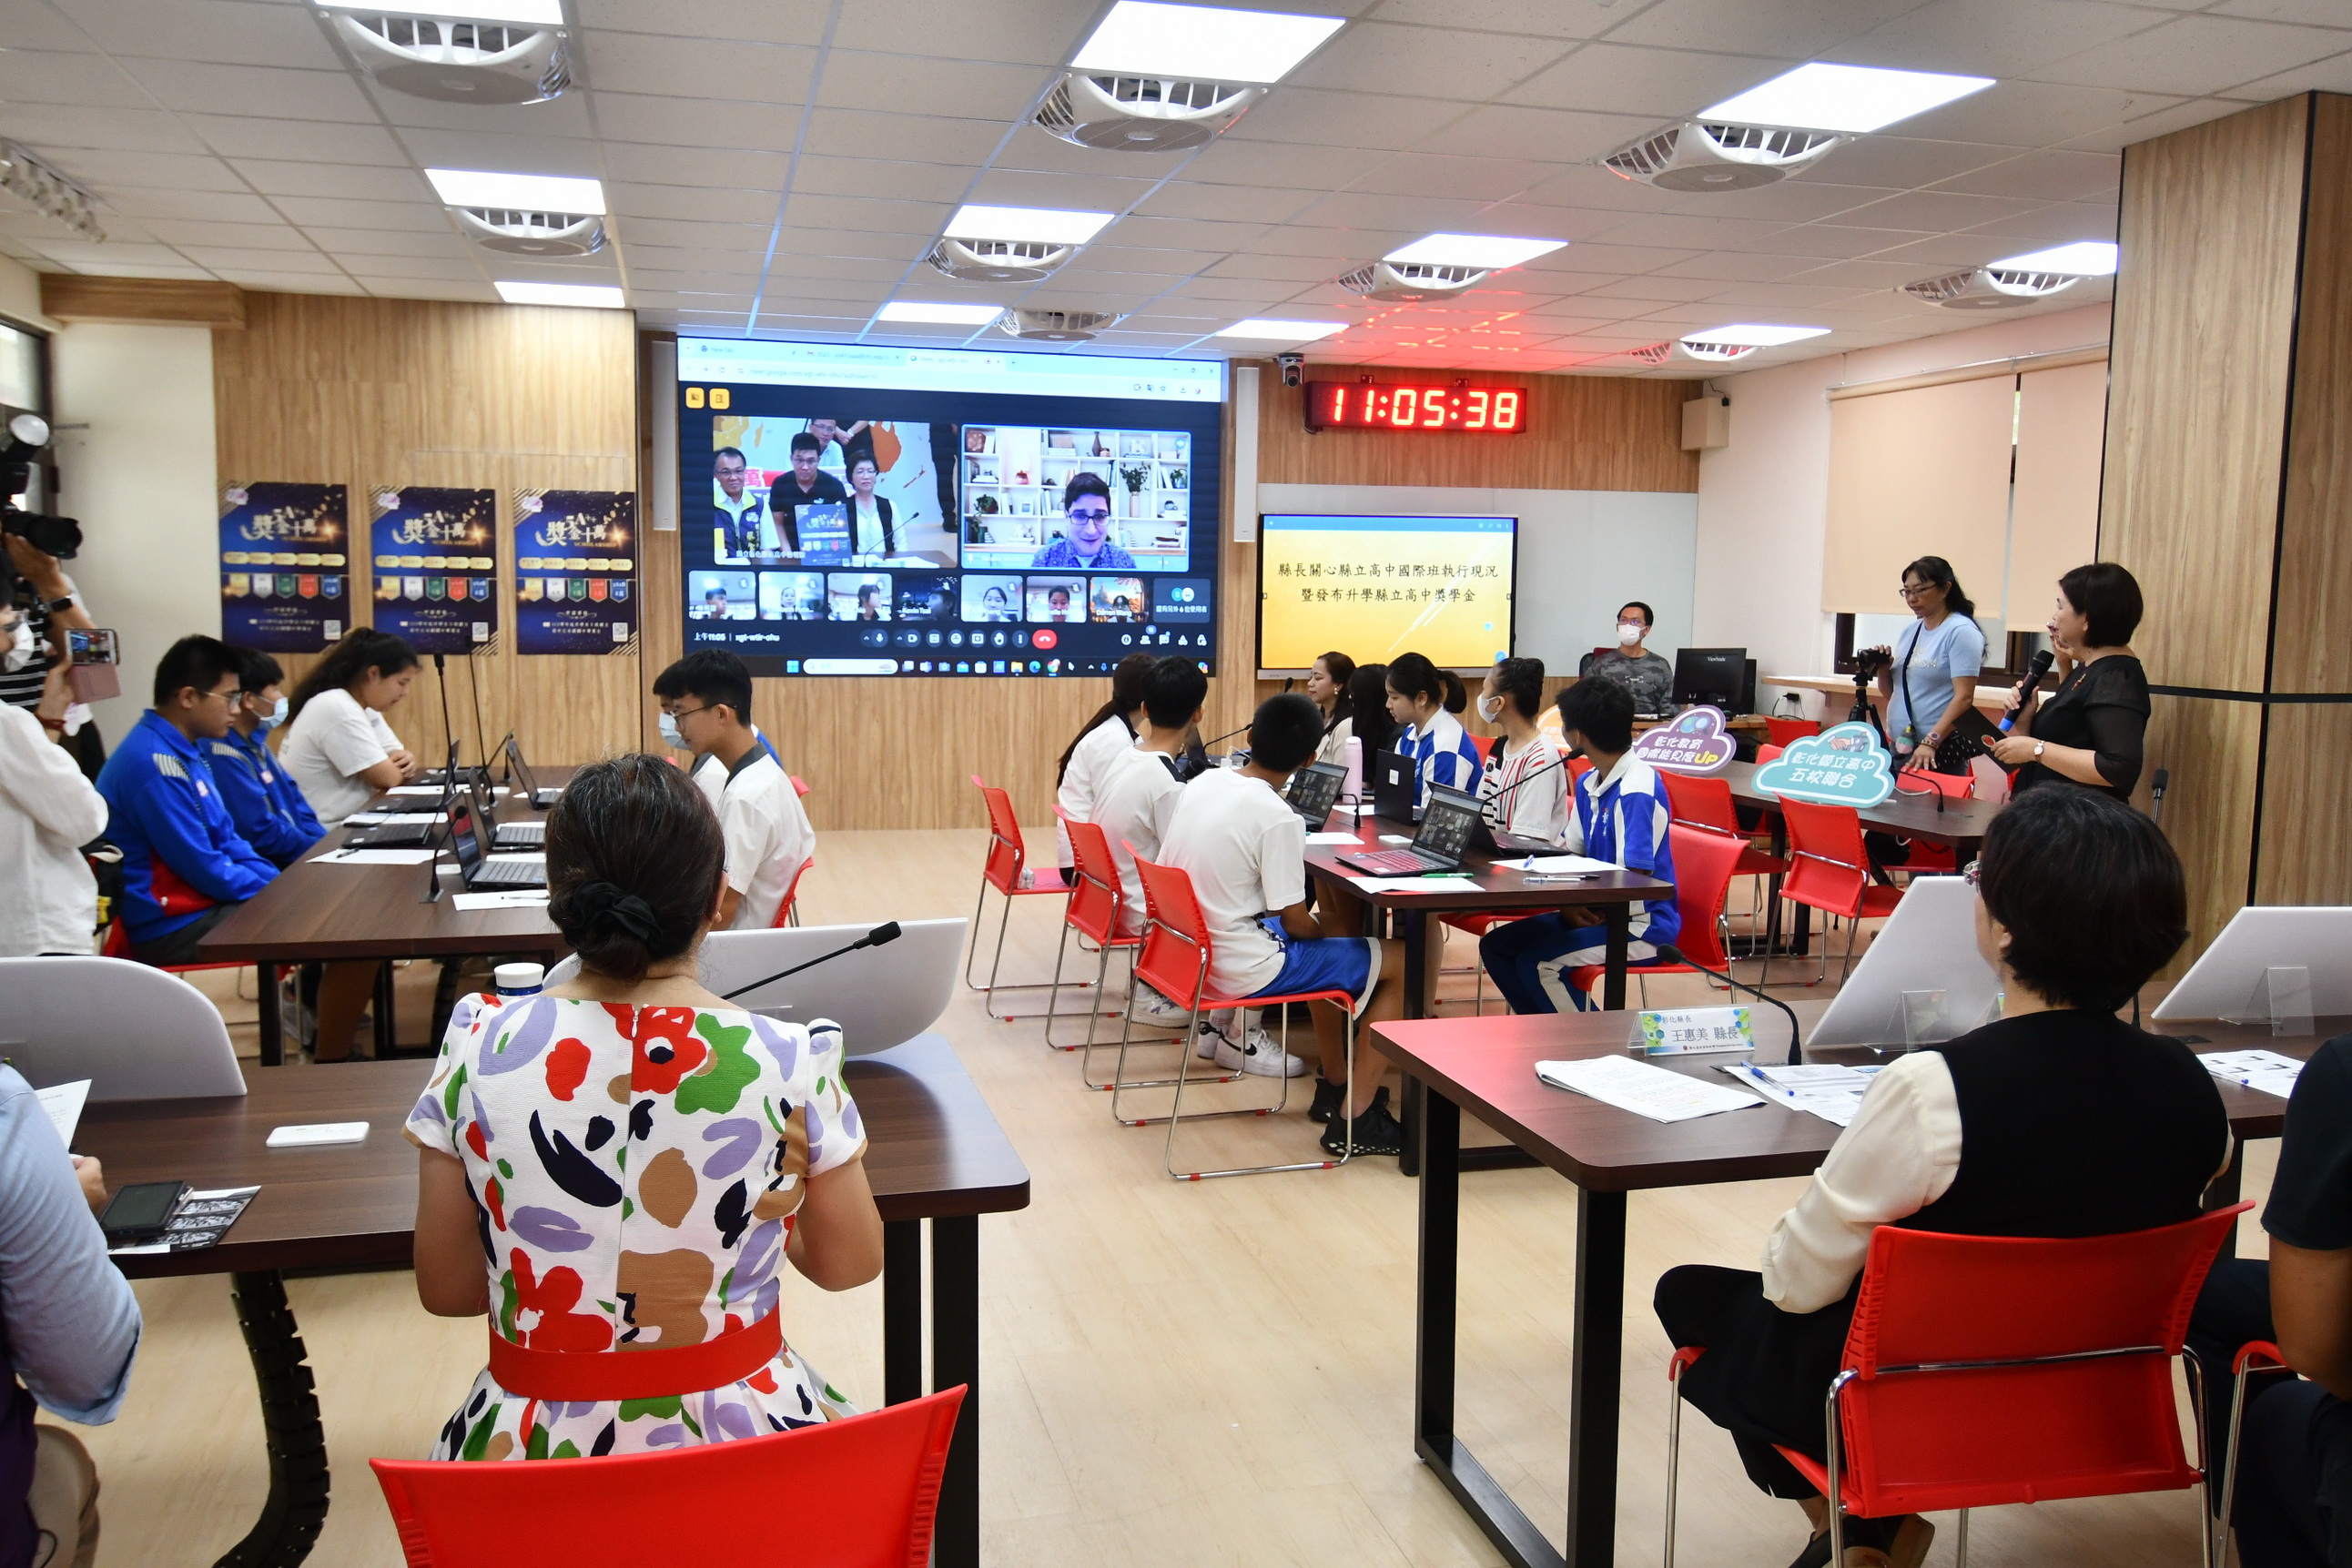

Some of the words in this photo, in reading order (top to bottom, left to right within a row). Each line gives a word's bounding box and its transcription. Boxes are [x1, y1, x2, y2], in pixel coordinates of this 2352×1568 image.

[1333, 389, 1517, 429] 11:05:38
[1277, 562, 1498, 578] 縣長關心縣立高中國際班執行現況
[1301, 587, 1476, 602] 暨發布升學縣立高中獎學金
[1654, 735, 1703, 751] 彰化教育
[1791, 752, 1876, 772] 彰化縣立高中
[1789, 767, 1858, 788] 五校聯合
[1671, 1027, 1708, 1042] 王惠美
[1713, 1026, 1739, 1040] 縣長
